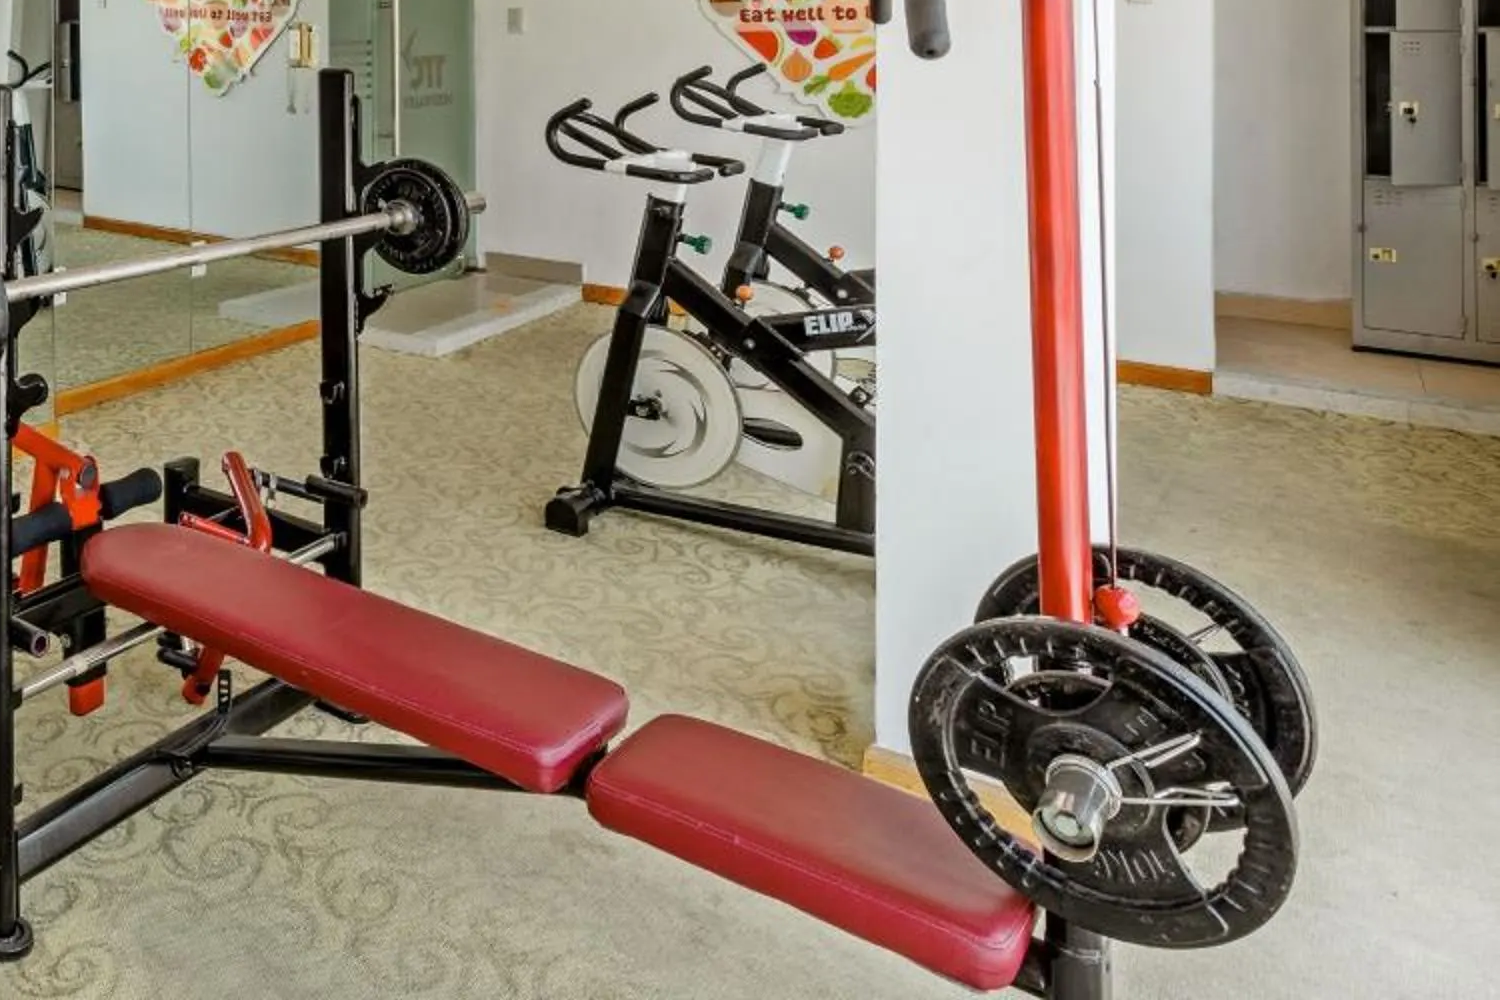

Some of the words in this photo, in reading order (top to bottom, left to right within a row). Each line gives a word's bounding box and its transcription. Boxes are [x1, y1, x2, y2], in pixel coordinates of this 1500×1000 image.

[739, 7, 776, 23] Eat
[781, 6, 825, 23] well
[832, 5, 857, 20] to
